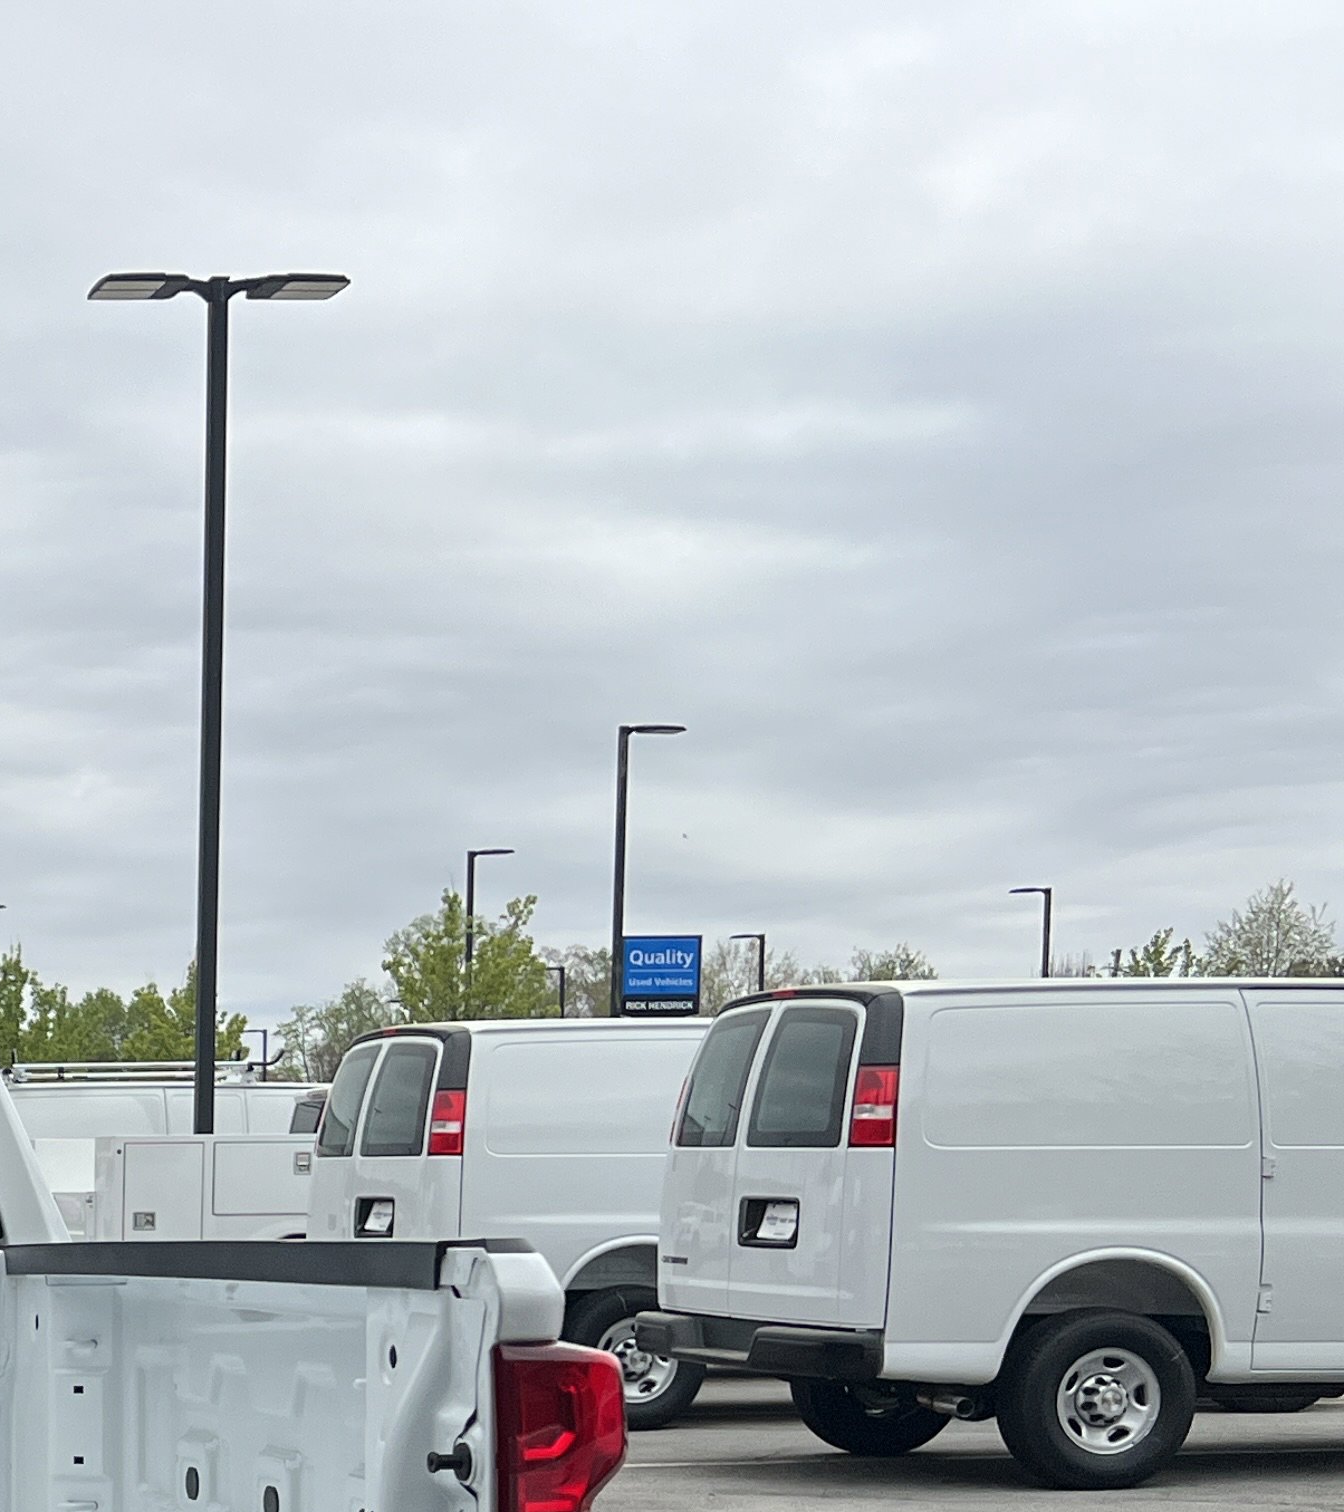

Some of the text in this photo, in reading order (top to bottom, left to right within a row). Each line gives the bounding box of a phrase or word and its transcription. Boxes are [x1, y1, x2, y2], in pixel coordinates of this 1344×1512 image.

[629, 949, 694, 968] Quality
[628, 977, 694, 987] Used Vehicles
[625, 1000, 694, 1010] RICK HENDRICK
